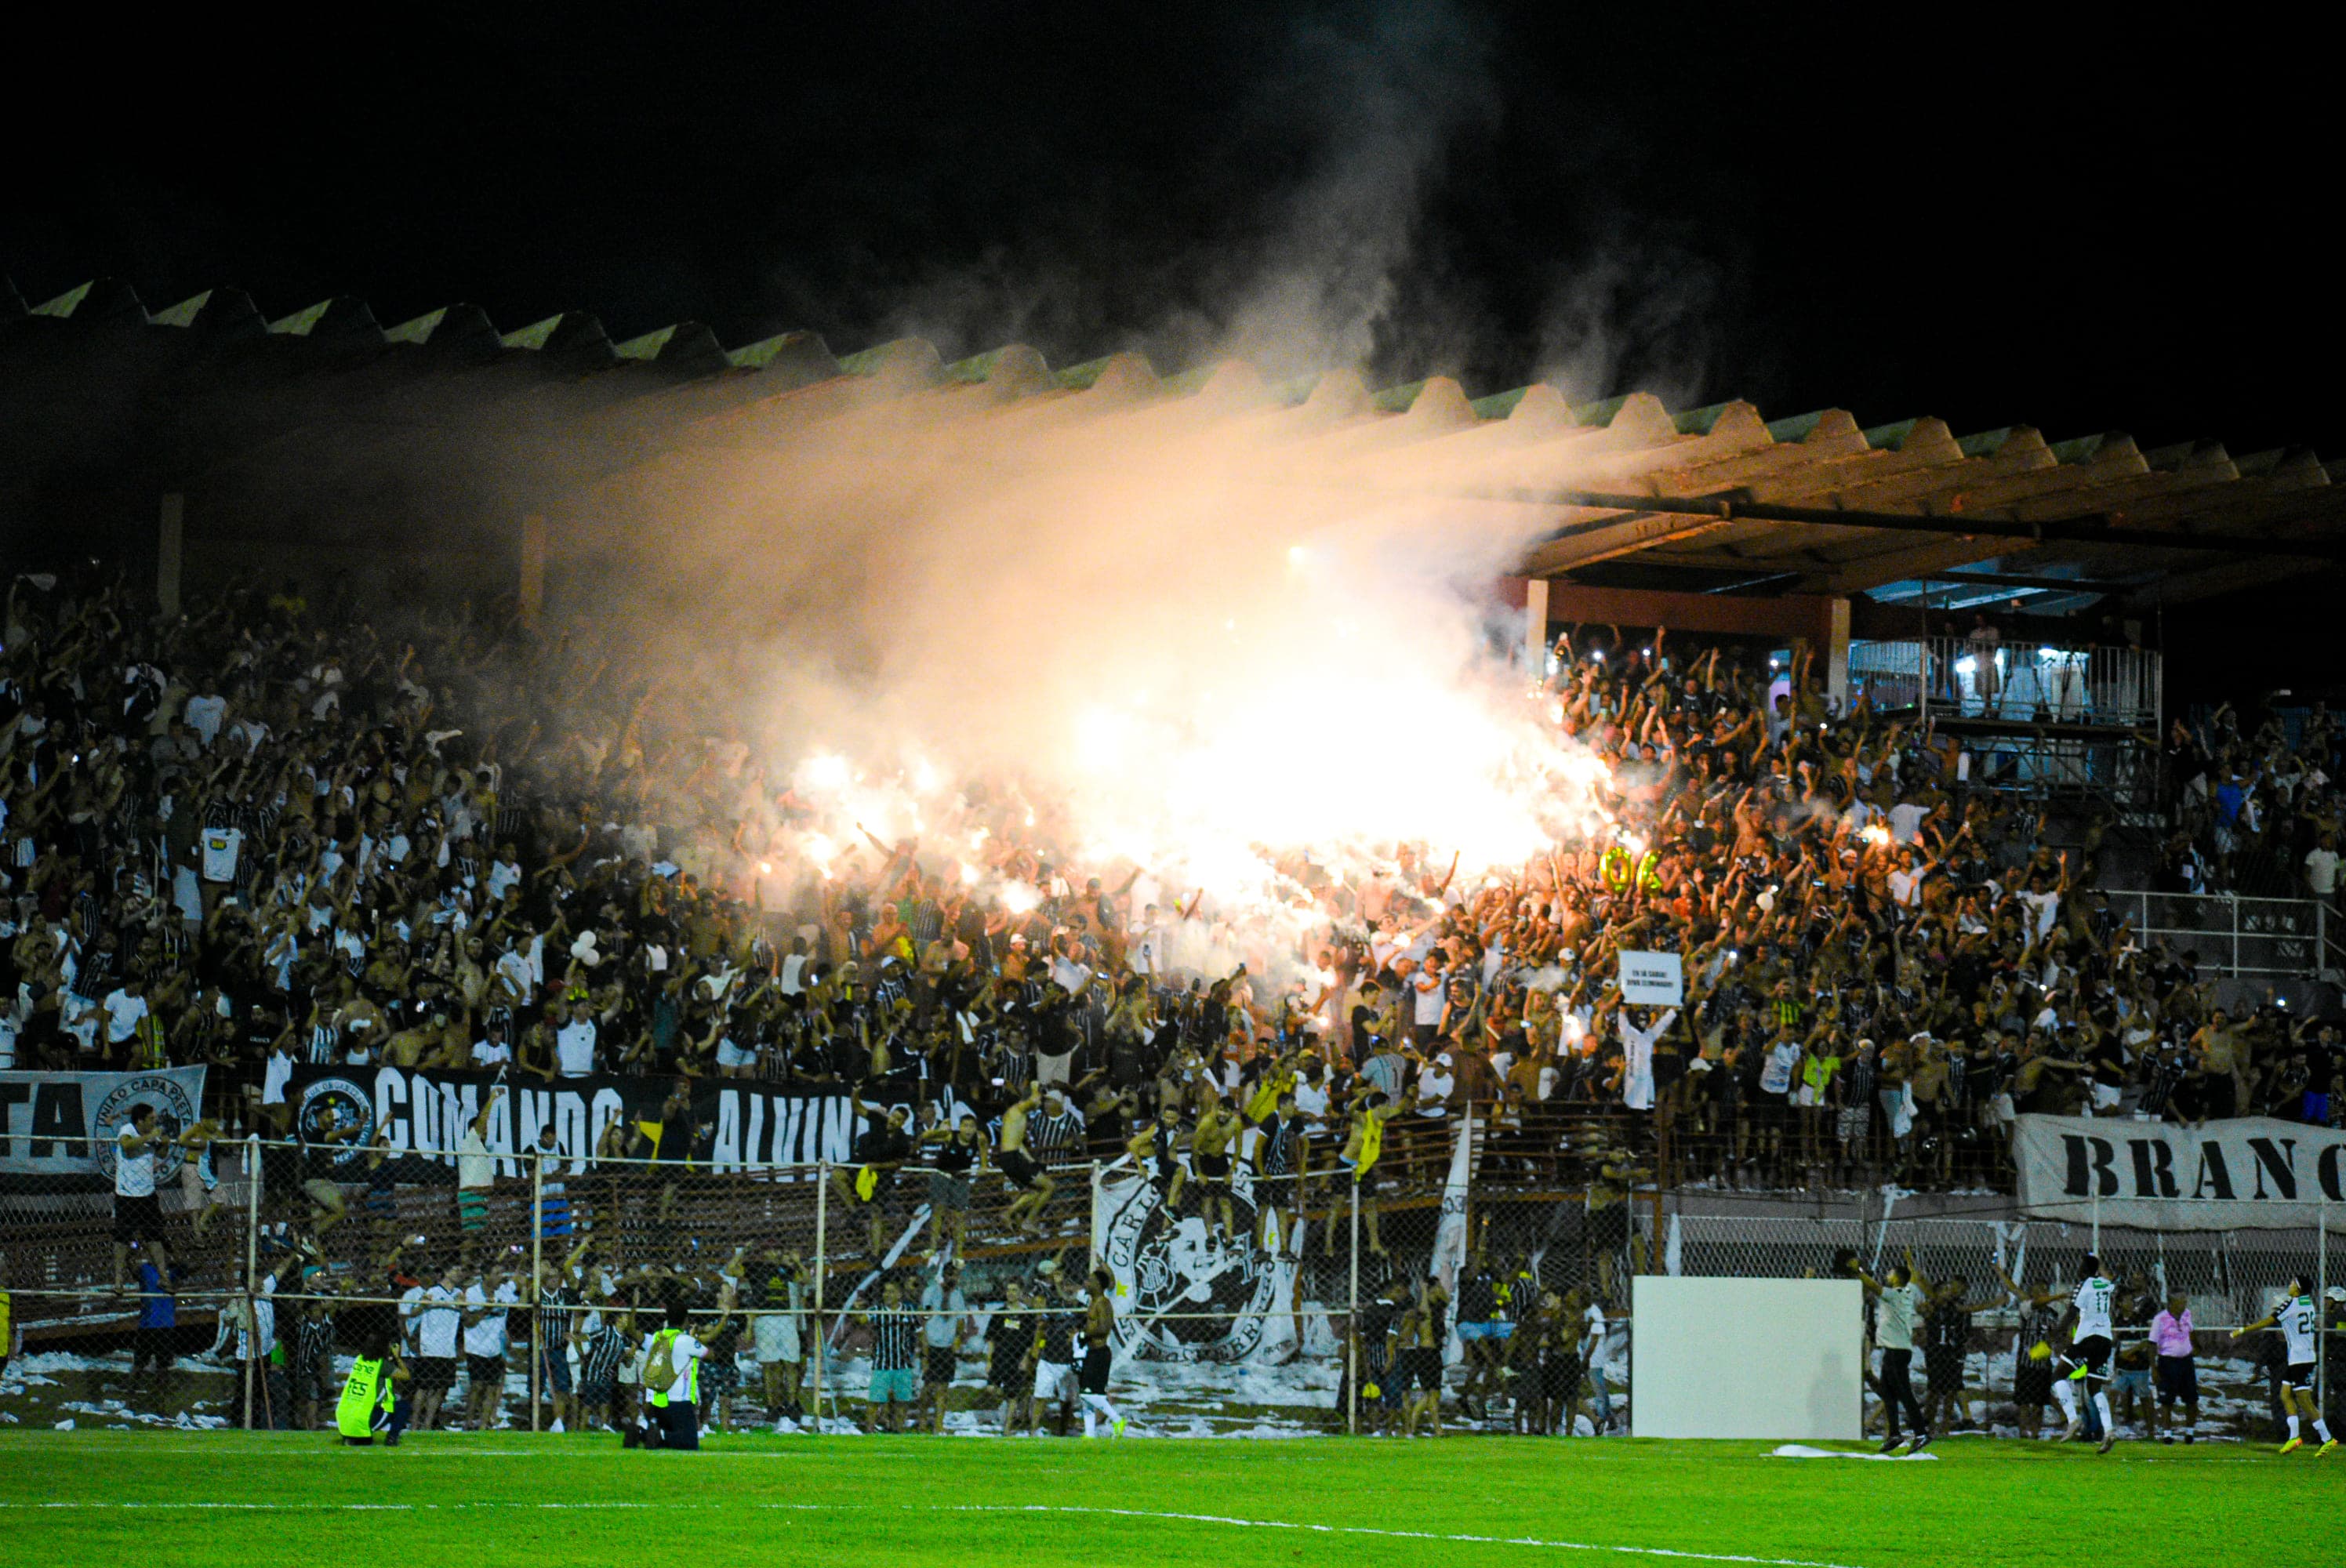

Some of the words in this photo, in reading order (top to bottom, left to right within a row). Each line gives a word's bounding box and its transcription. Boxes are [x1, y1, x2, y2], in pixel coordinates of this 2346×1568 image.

[130, 1078, 167, 1093] CAPA
[168, 1086, 193, 1127] PRETA
[375, 1066, 623, 1179] COMANDO
[2096, 1290, 2108, 1314] 17
